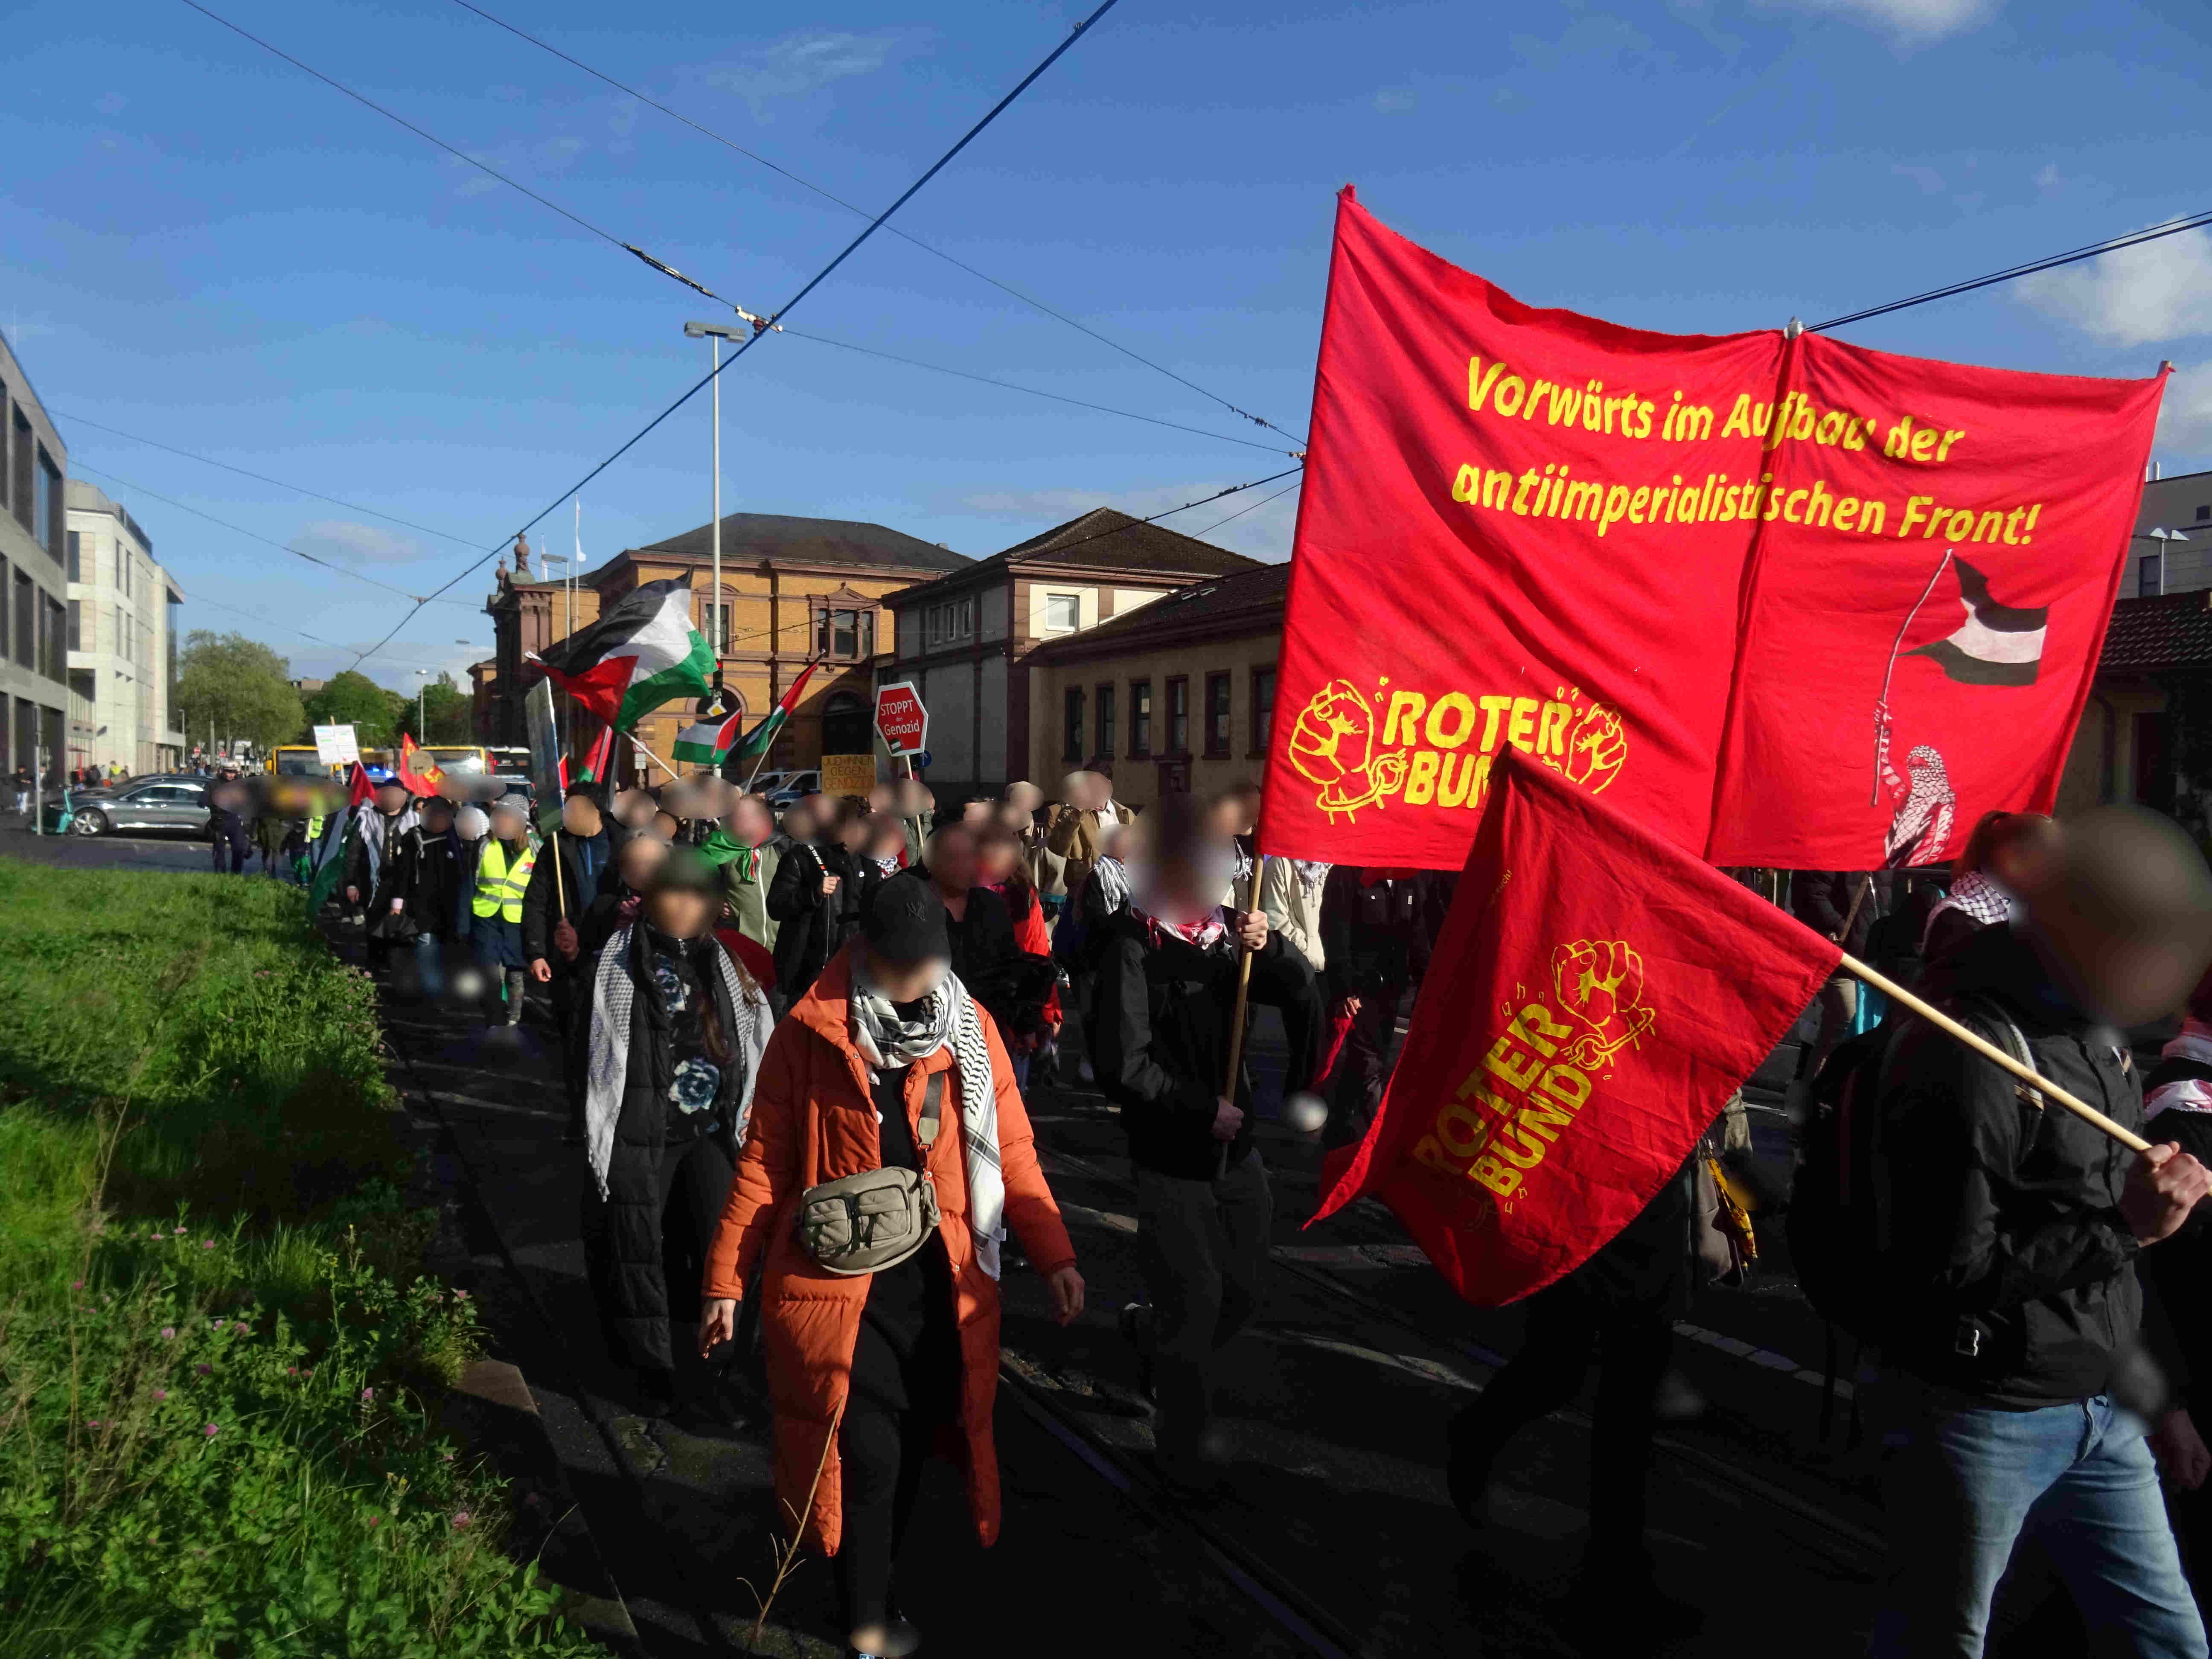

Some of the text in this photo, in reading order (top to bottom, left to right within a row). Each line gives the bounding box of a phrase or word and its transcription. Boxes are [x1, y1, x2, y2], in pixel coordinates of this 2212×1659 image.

[1468, 356, 1965, 463] Vorwärts im Aufbau der
[1452, 463, 2042, 545] antiimperialistischen Front!
[880, 699, 914, 716] STOPPT
[884, 719, 920, 736] Genozid
[1382, 690, 1573, 756] ROTER
[830, 766, 866, 776] GEGEN
[1403, 751, 1492, 809] BUN
[1412, 1004, 1574, 1175] ROTER
[1467, 1064, 1592, 1197] BUND
